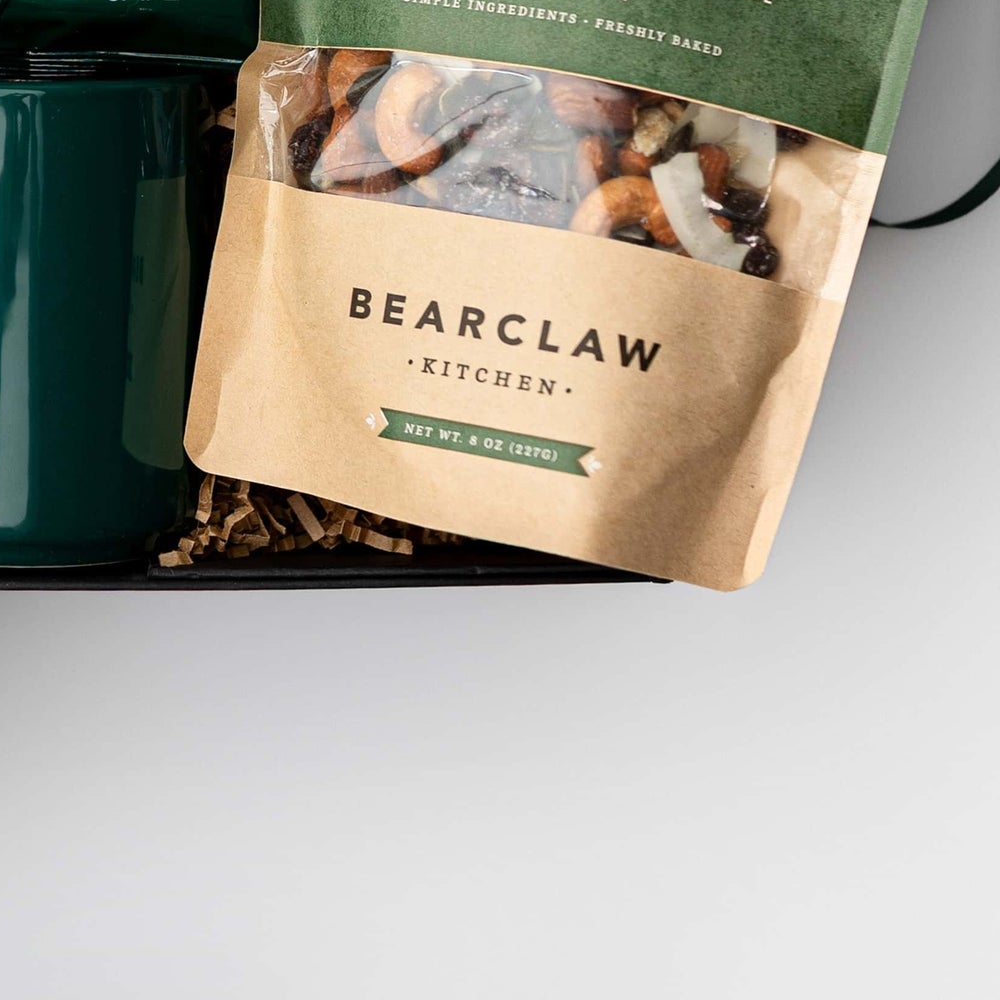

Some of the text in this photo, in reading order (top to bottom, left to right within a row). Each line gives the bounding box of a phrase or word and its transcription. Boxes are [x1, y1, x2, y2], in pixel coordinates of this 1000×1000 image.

[467, 0, 578, 25] INGREDIENTS
[595, 18, 667, 43] FRESHLY
[671, 35, 723, 58] BAKED
[348, 287, 662, 373] BEARCLAW
[420, 357, 557, 396] KITCHEN
[404, 422, 559, 463] NET WT. 8 OZ (227G)
